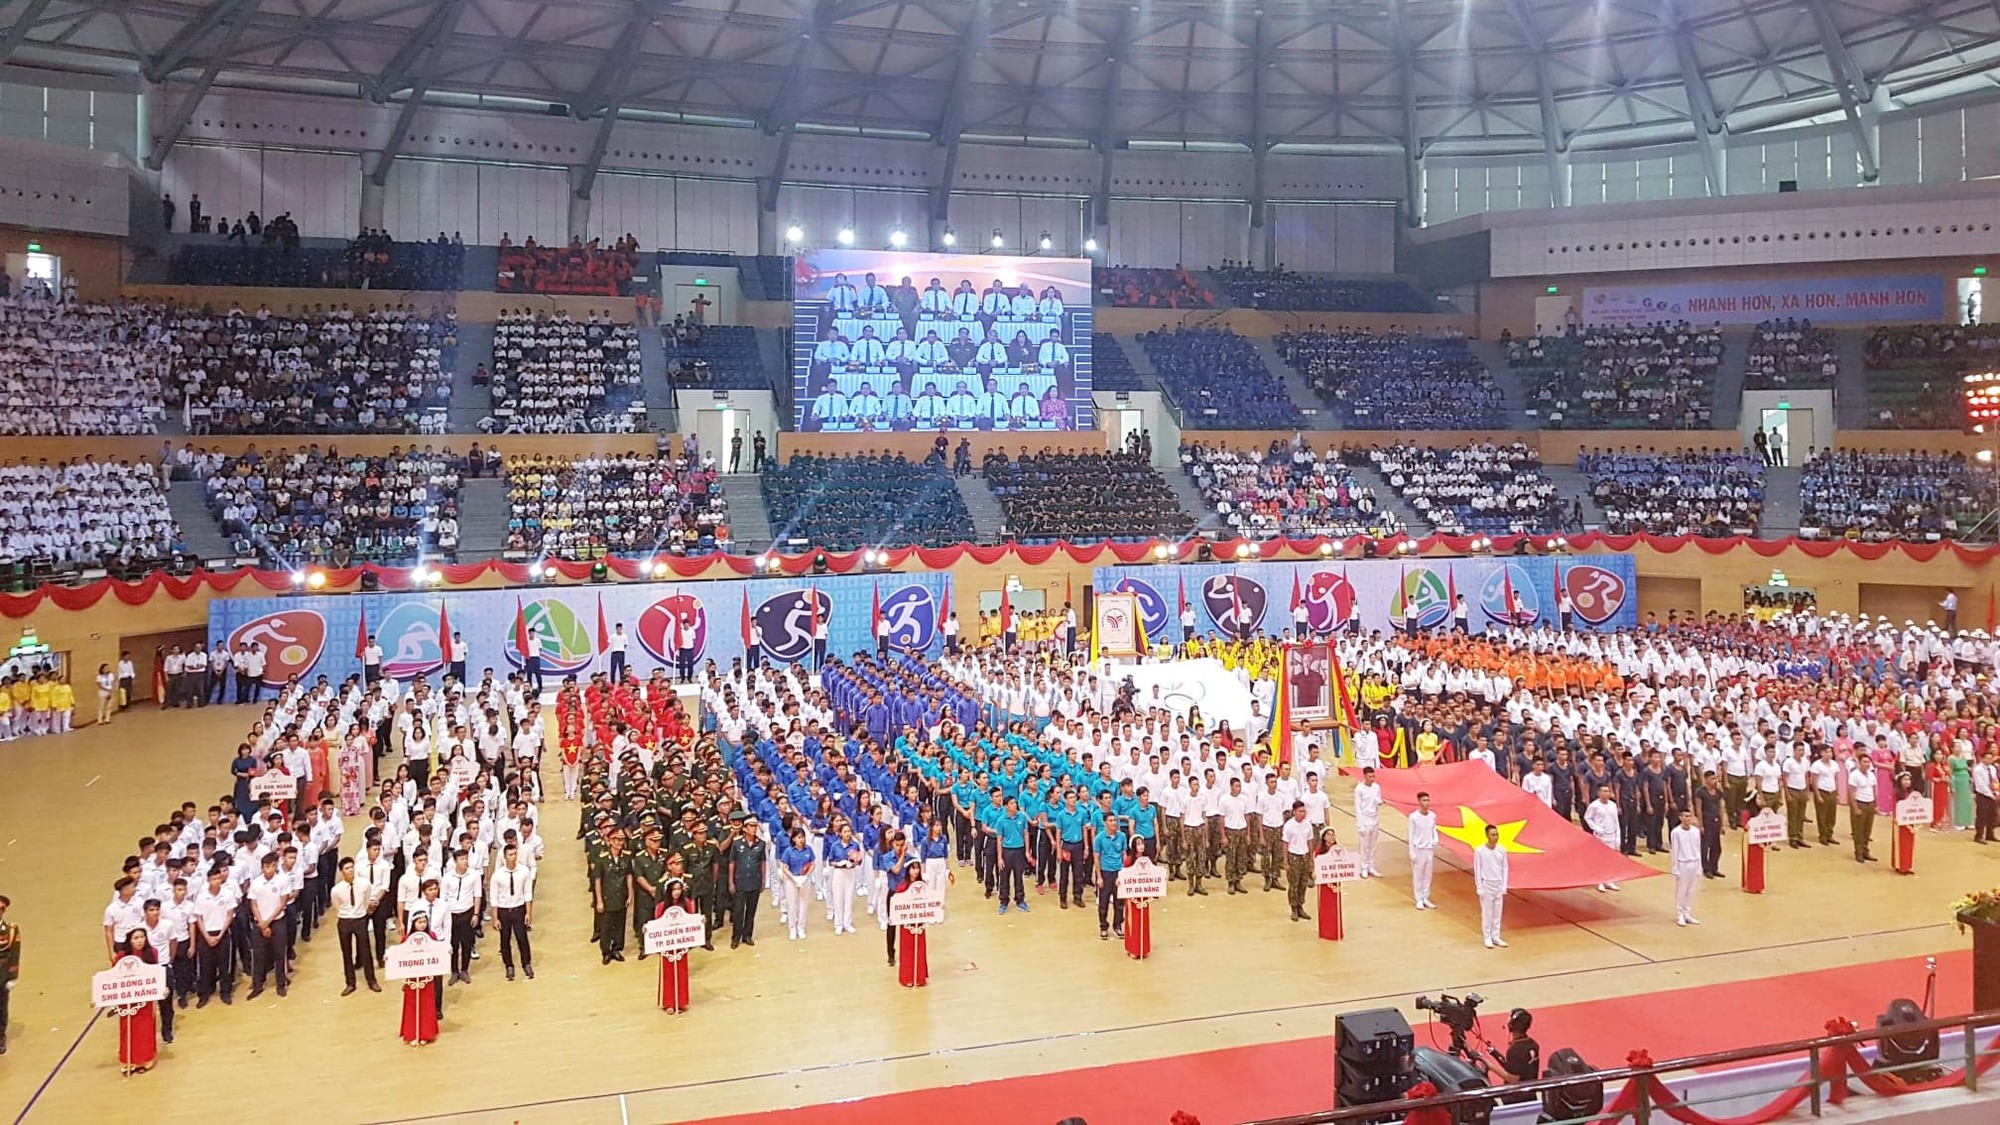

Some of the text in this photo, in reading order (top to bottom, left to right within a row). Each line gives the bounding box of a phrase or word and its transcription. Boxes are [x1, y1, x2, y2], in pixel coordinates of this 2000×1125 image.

[1688, 297, 1736, 312] NHANH
[1782, 294, 1800, 308] XA
[102, 982, 118, 990] CLB
